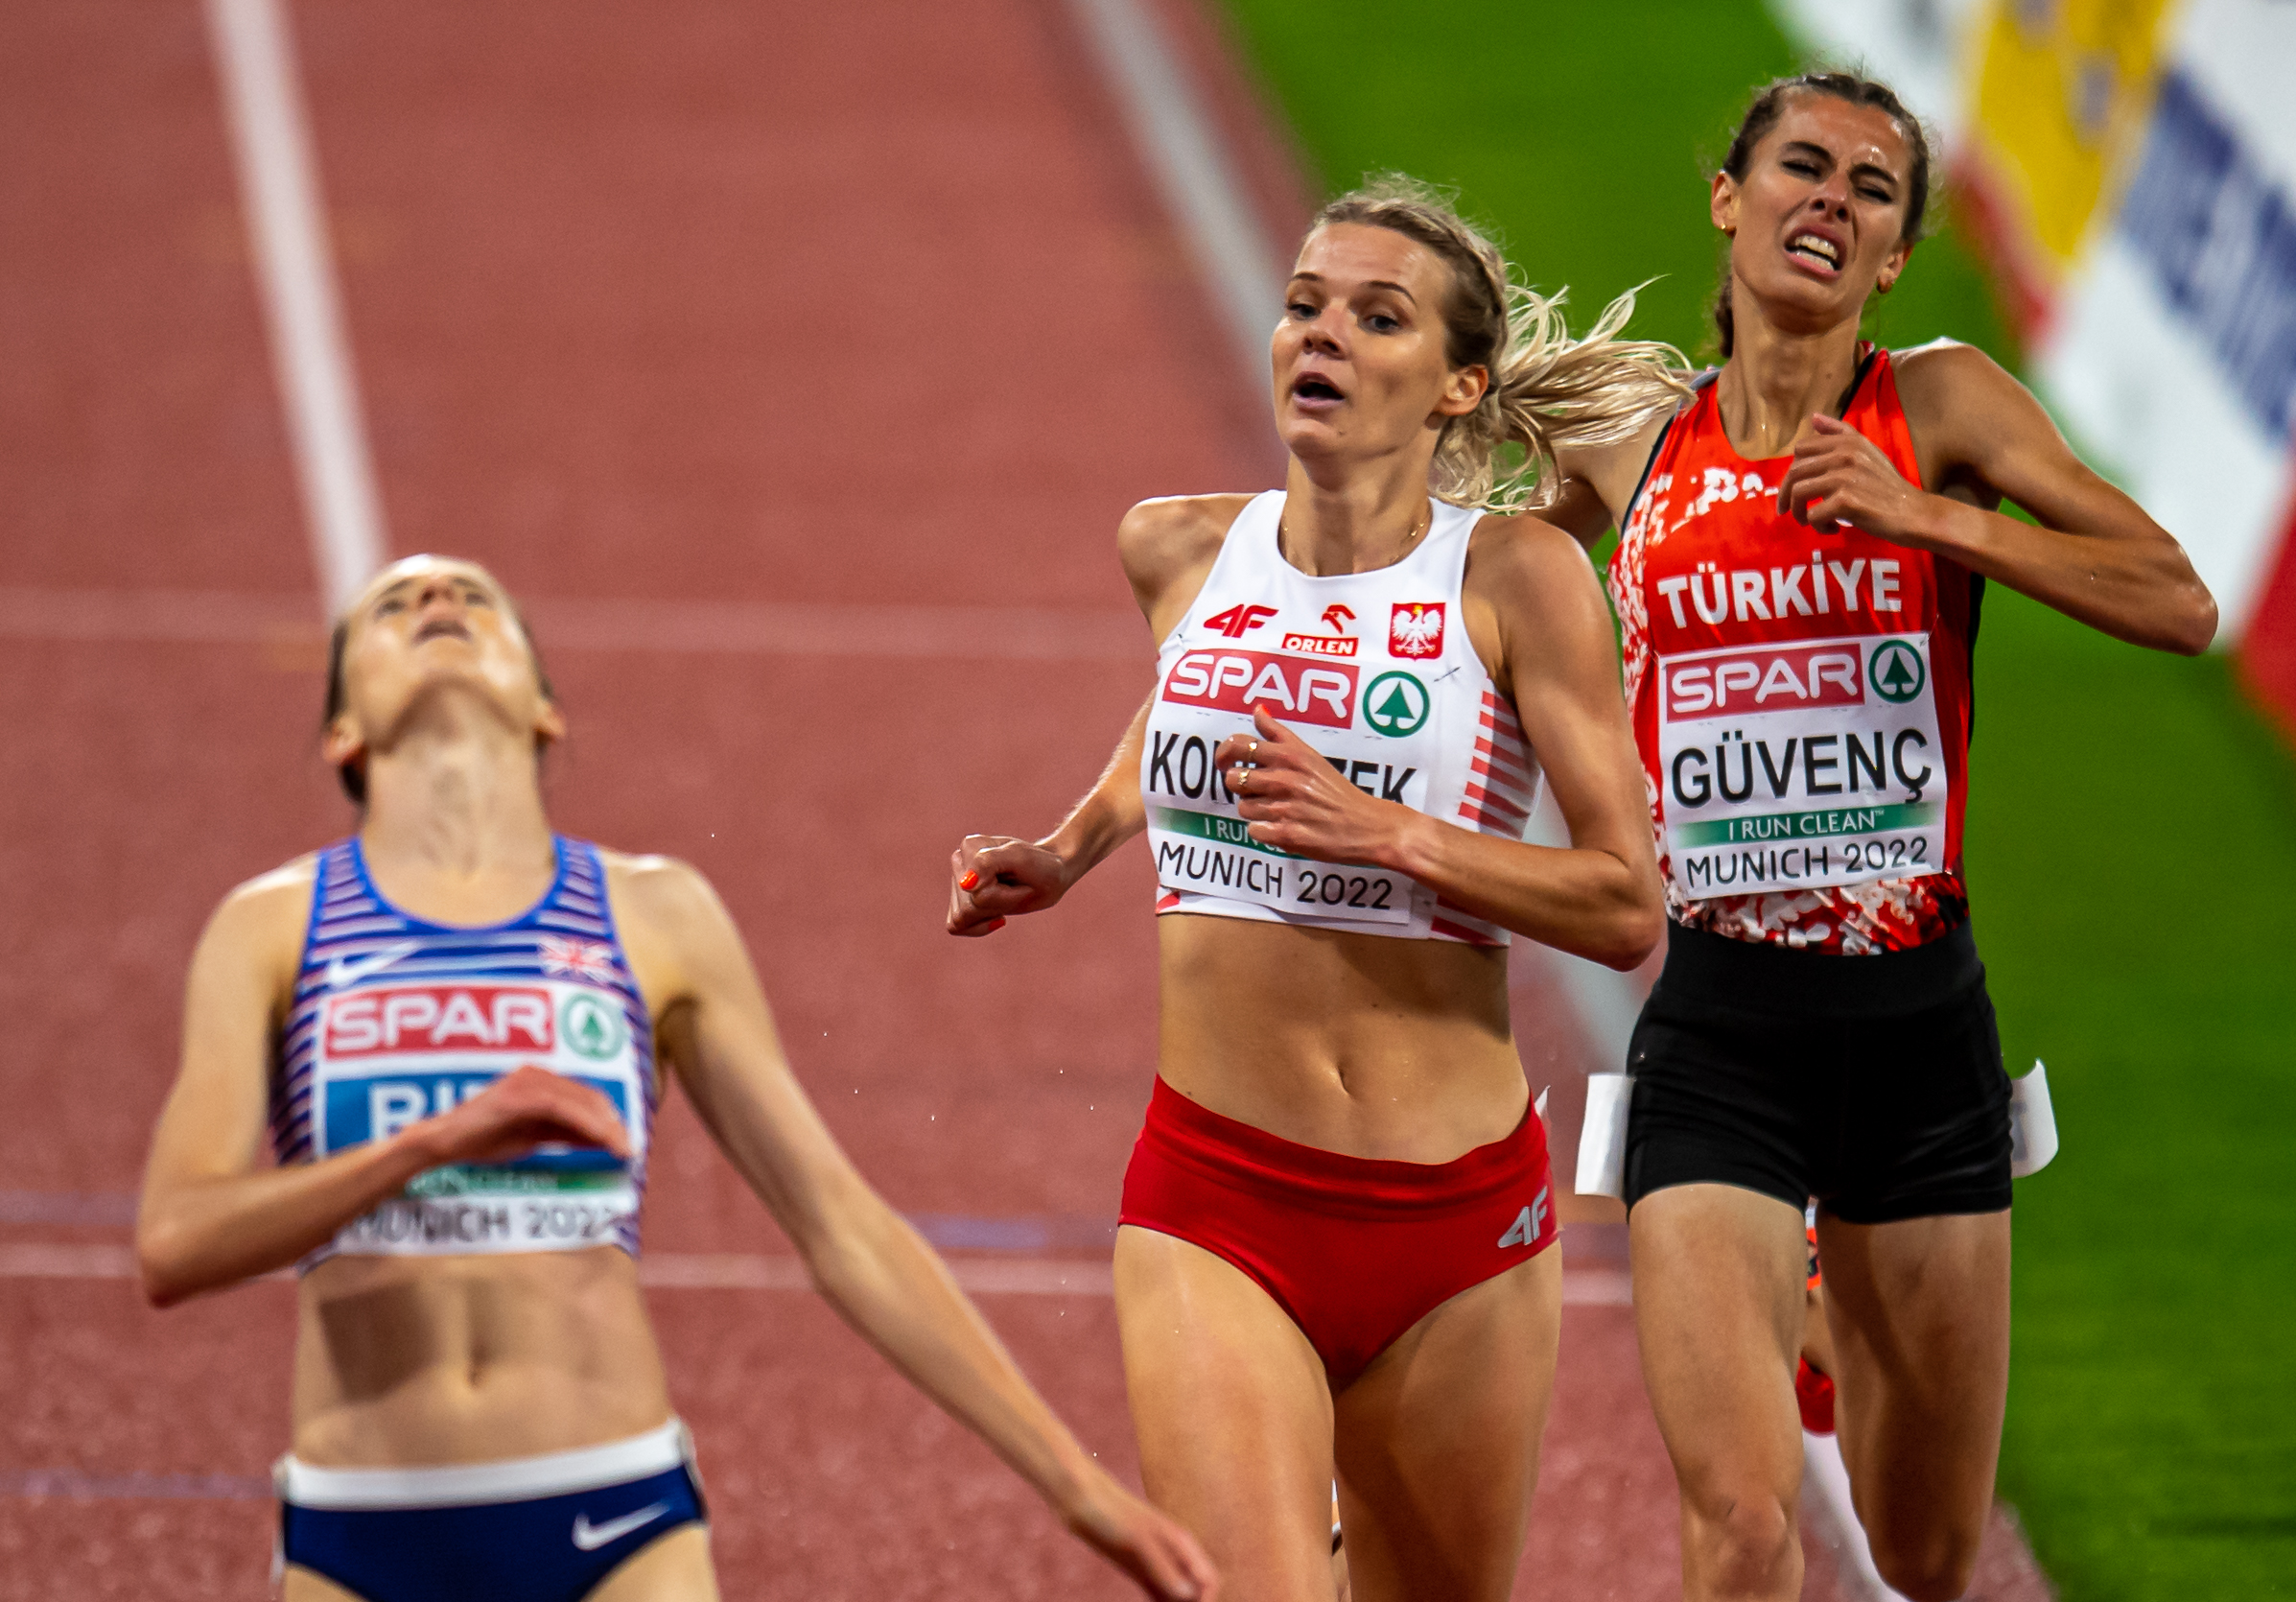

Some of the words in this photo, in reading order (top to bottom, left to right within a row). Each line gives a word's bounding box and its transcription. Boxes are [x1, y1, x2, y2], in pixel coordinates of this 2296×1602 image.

[1656, 551, 1903, 629] TÜRKİYE
[1203, 603, 1279, 639] 4F
[1286, 637, 1354, 655] ORLEN
[1170, 653, 1353, 719] SPAR
[1671, 652, 1858, 714] SPAR
[1671, 728, 1933, 810] GÜVENÇ
[1728, 821, 1734, 841] I
[1742, 816, 1792, 839] RUN
[1159, 839, 1283, 899] MUNICH
[1297, 869, 1394, 910] 2022
[1686, 845, 1829, 888] MUNICH
[1844, 836, 1928, 874] 2022
[330, 993, 551, 1051] SPAR
